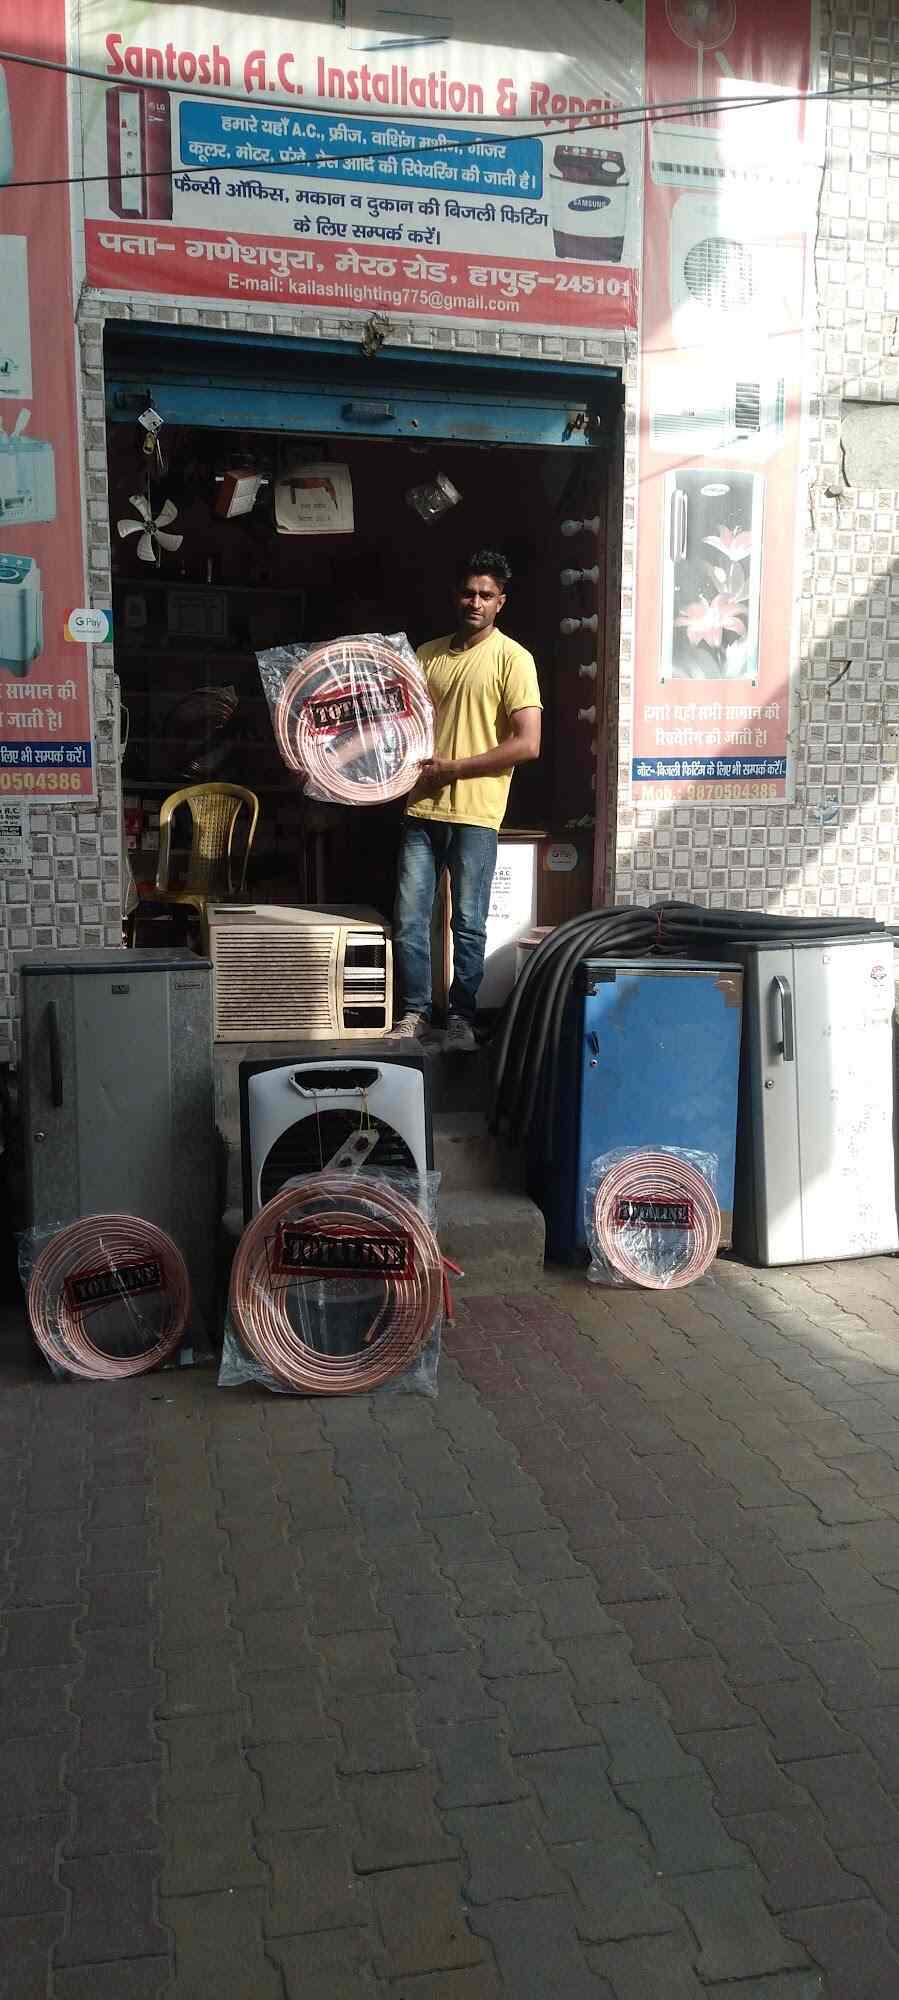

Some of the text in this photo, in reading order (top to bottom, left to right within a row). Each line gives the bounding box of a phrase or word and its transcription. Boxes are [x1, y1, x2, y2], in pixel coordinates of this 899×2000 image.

[105, 33, 623, 134] Santosh A.C. Installation & Repair
[156, 103, 166, 112] LG
[220, 114, 258, 133] हमारे
[261, 116, 290, 137] यहाँ
[329, 123, 367, 145] फ्रीज,
[371, 128, 416, 148] वाशिंग
[188, 141, 231, 163] कूलर,
[235, 142, 274, 163] मोटर,
[378, 155, 398, 175] की
[401, 157, 457, 181] रिपेयरिंग
[461, 164, 480, 183] की
[483, 167, 516, 188] जाती
[518, 171, 536, 190] है।
[173, 174, 550, 227] फैन्सी ऑफिस, मकान व दुकान की बिजली फिटिंग
[292, 216, 441, 246] के लिए सम्पर्क करें।
[97, 232, 176, 257] पता-
[185, 237, 325, 278] गणेशपुरा,
[334, 247, 397, 277] मेरठ
[402, 253, 458, 285] रोड,
[228, 272, 520, 313] E-mail: kailashlighting775@gmail.com
[6, 683, 54, 699] सामान
[57, 680, 78, 700] की
[7, 708, 44, 728] जाती
[45, 708, 62, 732] है।
[764, 702, 781, 720] की
[723, 728, 752, 744] जाती
[20, 746, 33, 763] भी
[34, 746, 64, 763] सम्पर्क
[65, 746, 86, 763] करें।
[657, 761, 680, 776] बिजली
[706, 760, 715, 776] के
[717, 760, 731, 776] लिए
[732, 760, 741, 776] भी
[743, 760, 766, 776] सम्पर्क
